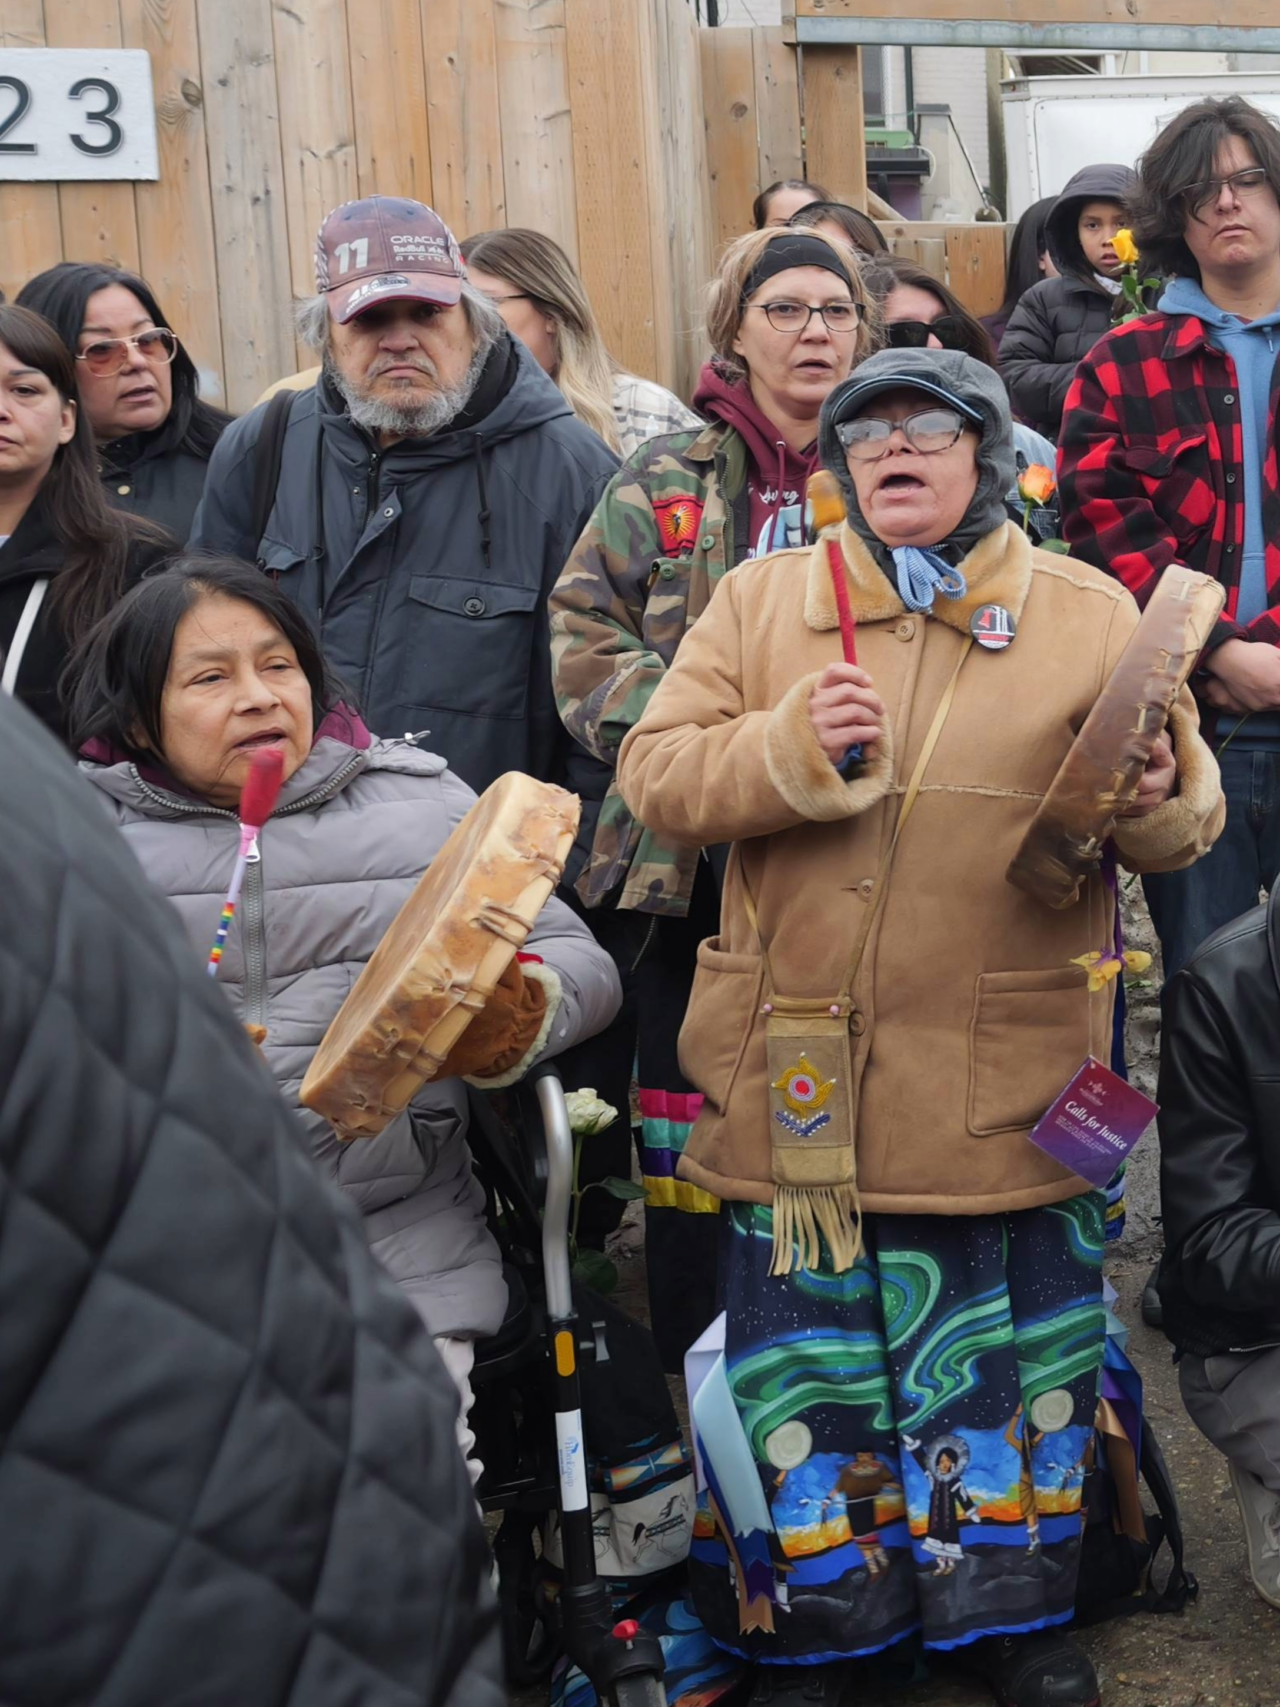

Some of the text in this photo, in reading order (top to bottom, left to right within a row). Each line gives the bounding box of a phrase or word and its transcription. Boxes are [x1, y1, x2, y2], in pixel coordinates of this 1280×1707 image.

[390, 235, 445, 246] ORACLE
[334, 238, 368, 274] 11
[395, 255, 449, 264] RACING
[1065, 1101, 1088, 1121] Calls
[1081, 1116, 1101, 1130] for
[1096, 1125, 1128, 1150] Justice
